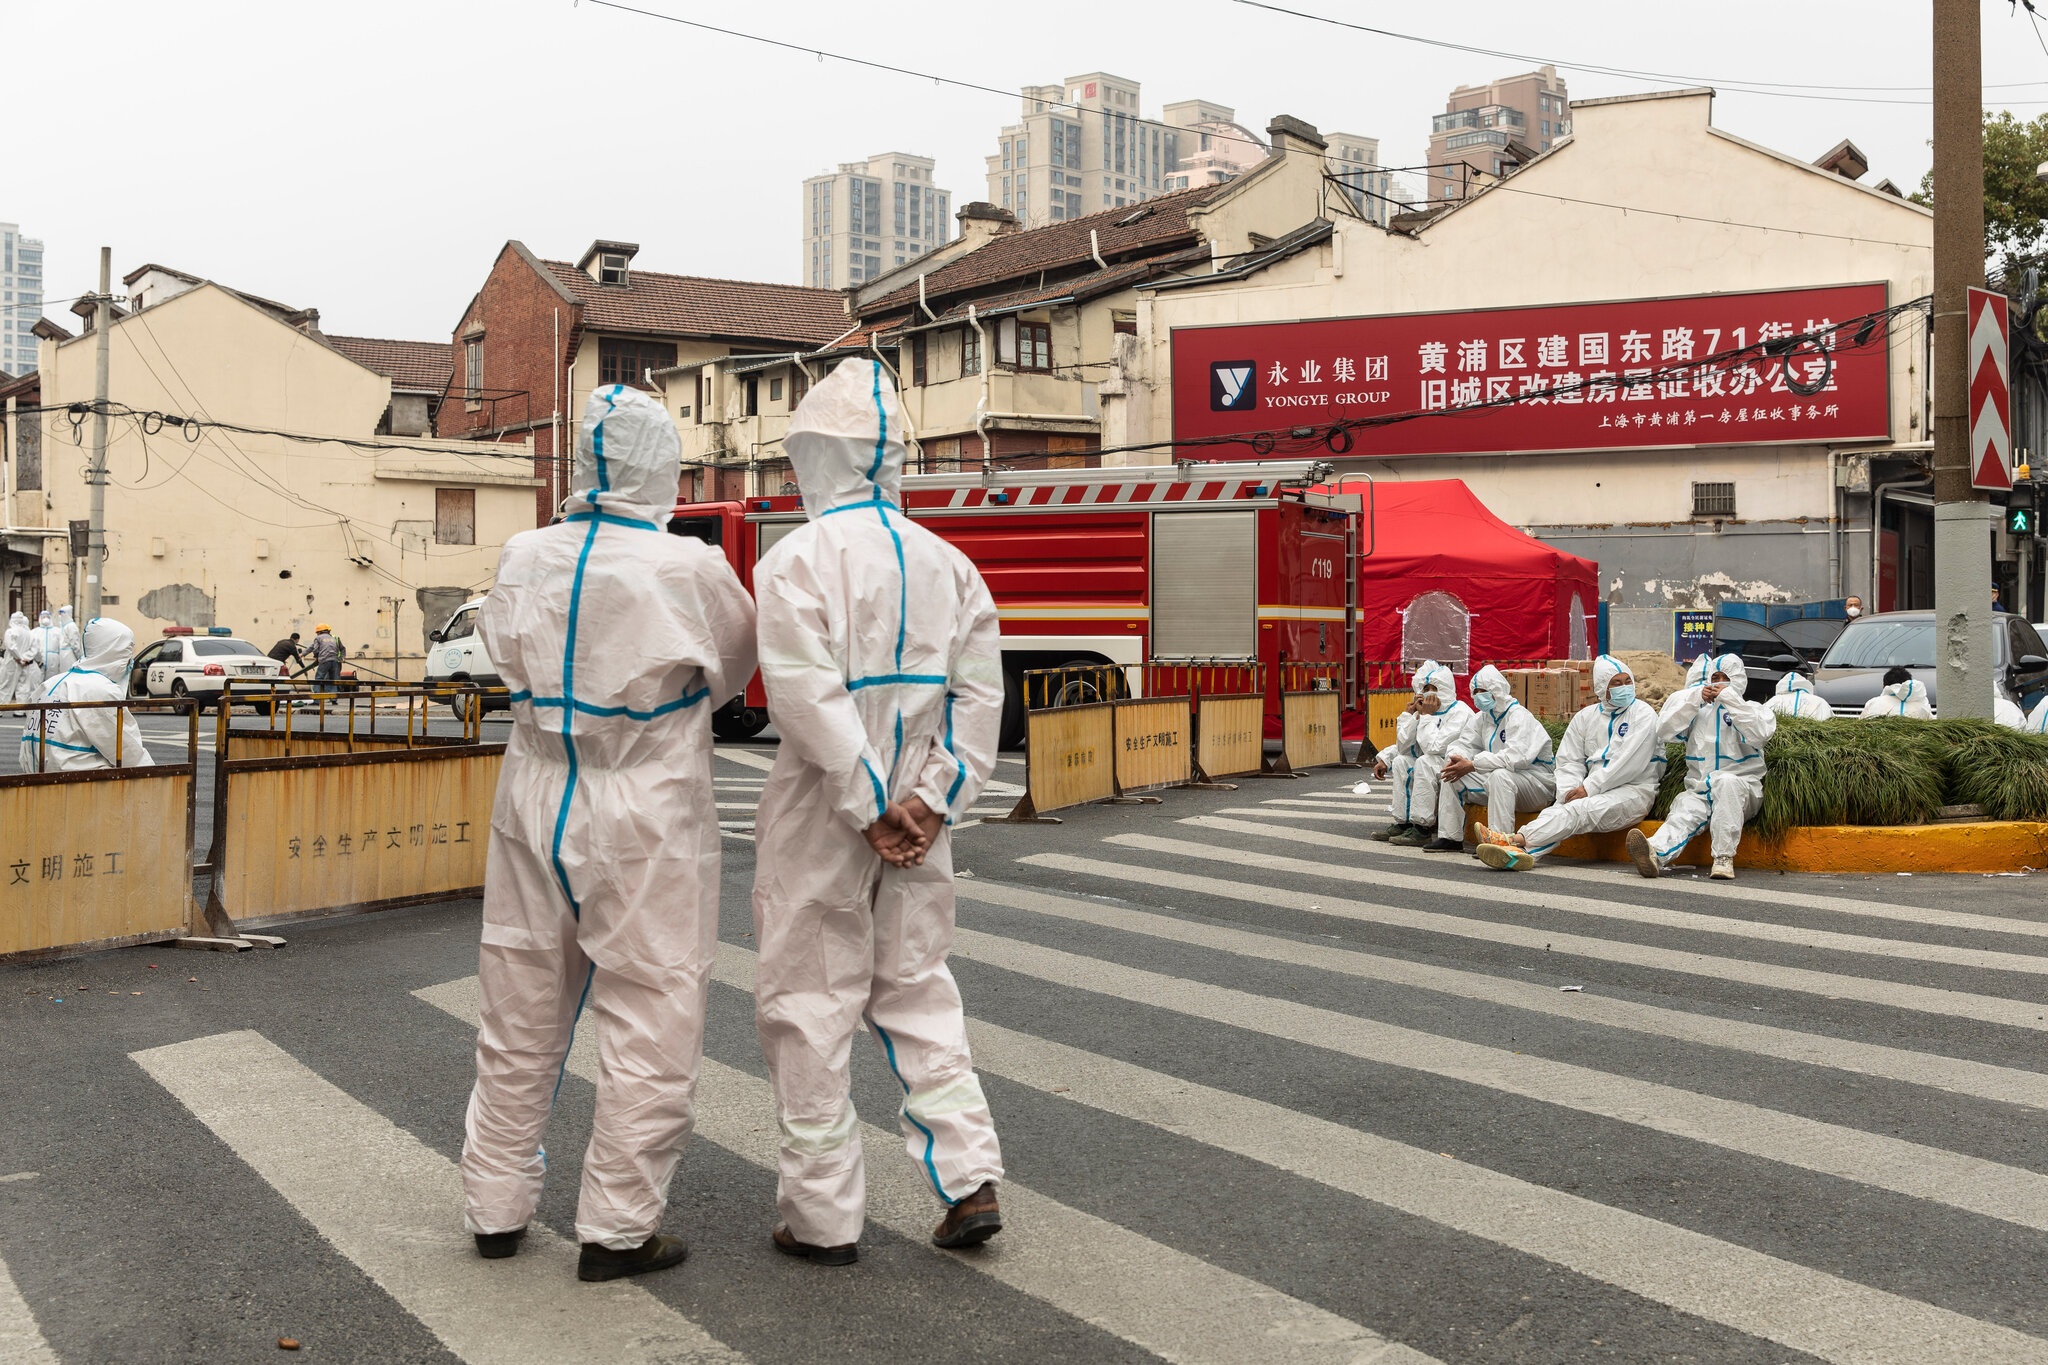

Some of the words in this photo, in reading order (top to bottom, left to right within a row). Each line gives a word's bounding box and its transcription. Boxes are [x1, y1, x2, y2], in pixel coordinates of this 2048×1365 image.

[1266, 355, 1389, 387] 永业集团
[1420, 357, 1838, 410] 旧城区改建房屋征收办公室
[1265, 394, 1329, 408] YONGYE
[1335, 391, 1391, 405] GROUP
[1598, 403, 1840, 429] 上海市黄浦第一房屋征收事务所
[1317, 558, 1332, 579] 119
[150, 670, 165, 684] 公安
[1125, 731, 1178, 751] 安全生产文明施工
[288, 822, 471, 860] 安全生产文明施工
[10, 851, 124, 886] 文明施工
